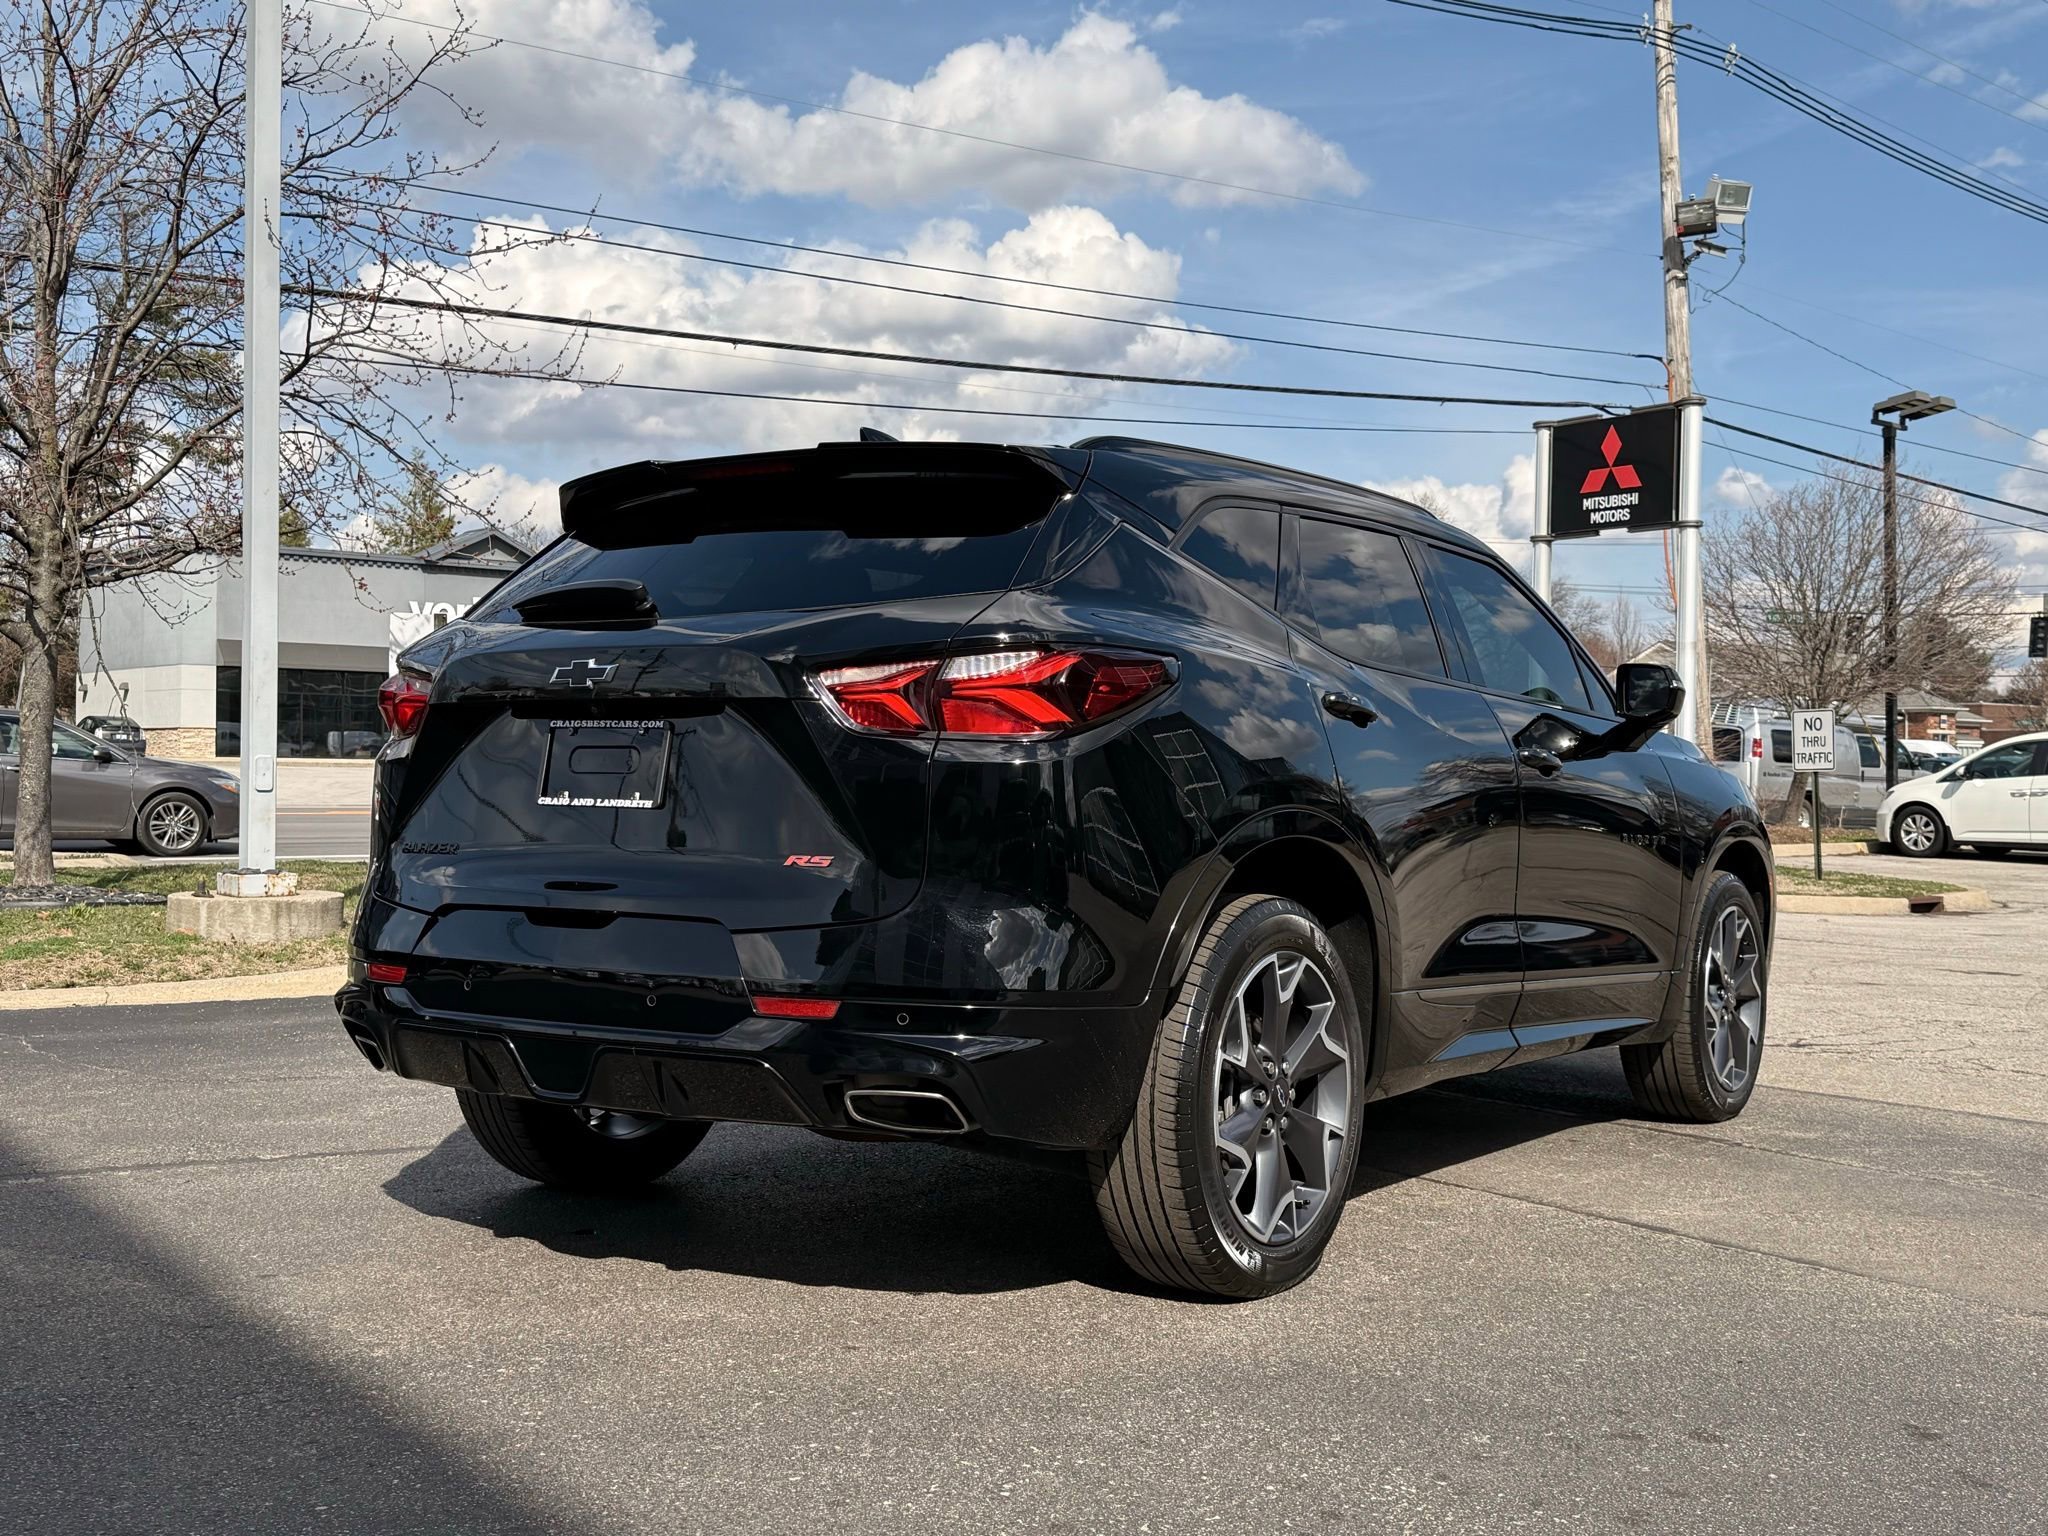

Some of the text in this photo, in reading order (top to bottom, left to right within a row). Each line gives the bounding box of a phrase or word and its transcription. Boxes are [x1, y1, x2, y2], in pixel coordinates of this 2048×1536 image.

[1583, 492, 1639, 511] MITSUBISHI
[1590, 508, 1631, 524] MOTORS
[550, 720, 664, 728] CRAIGSBESTCARS.COM
[1803, 717, 1823, 731] NO
[1801, 736, 1826, 748] THRU
[1796, 752, 1832, 764] TRAFFIC
[538, 797, 653, 808] CRAIG AND LANDRETH
[402, 841, 460, 855] BLAZER
[783, 854, 835, 867] RS
